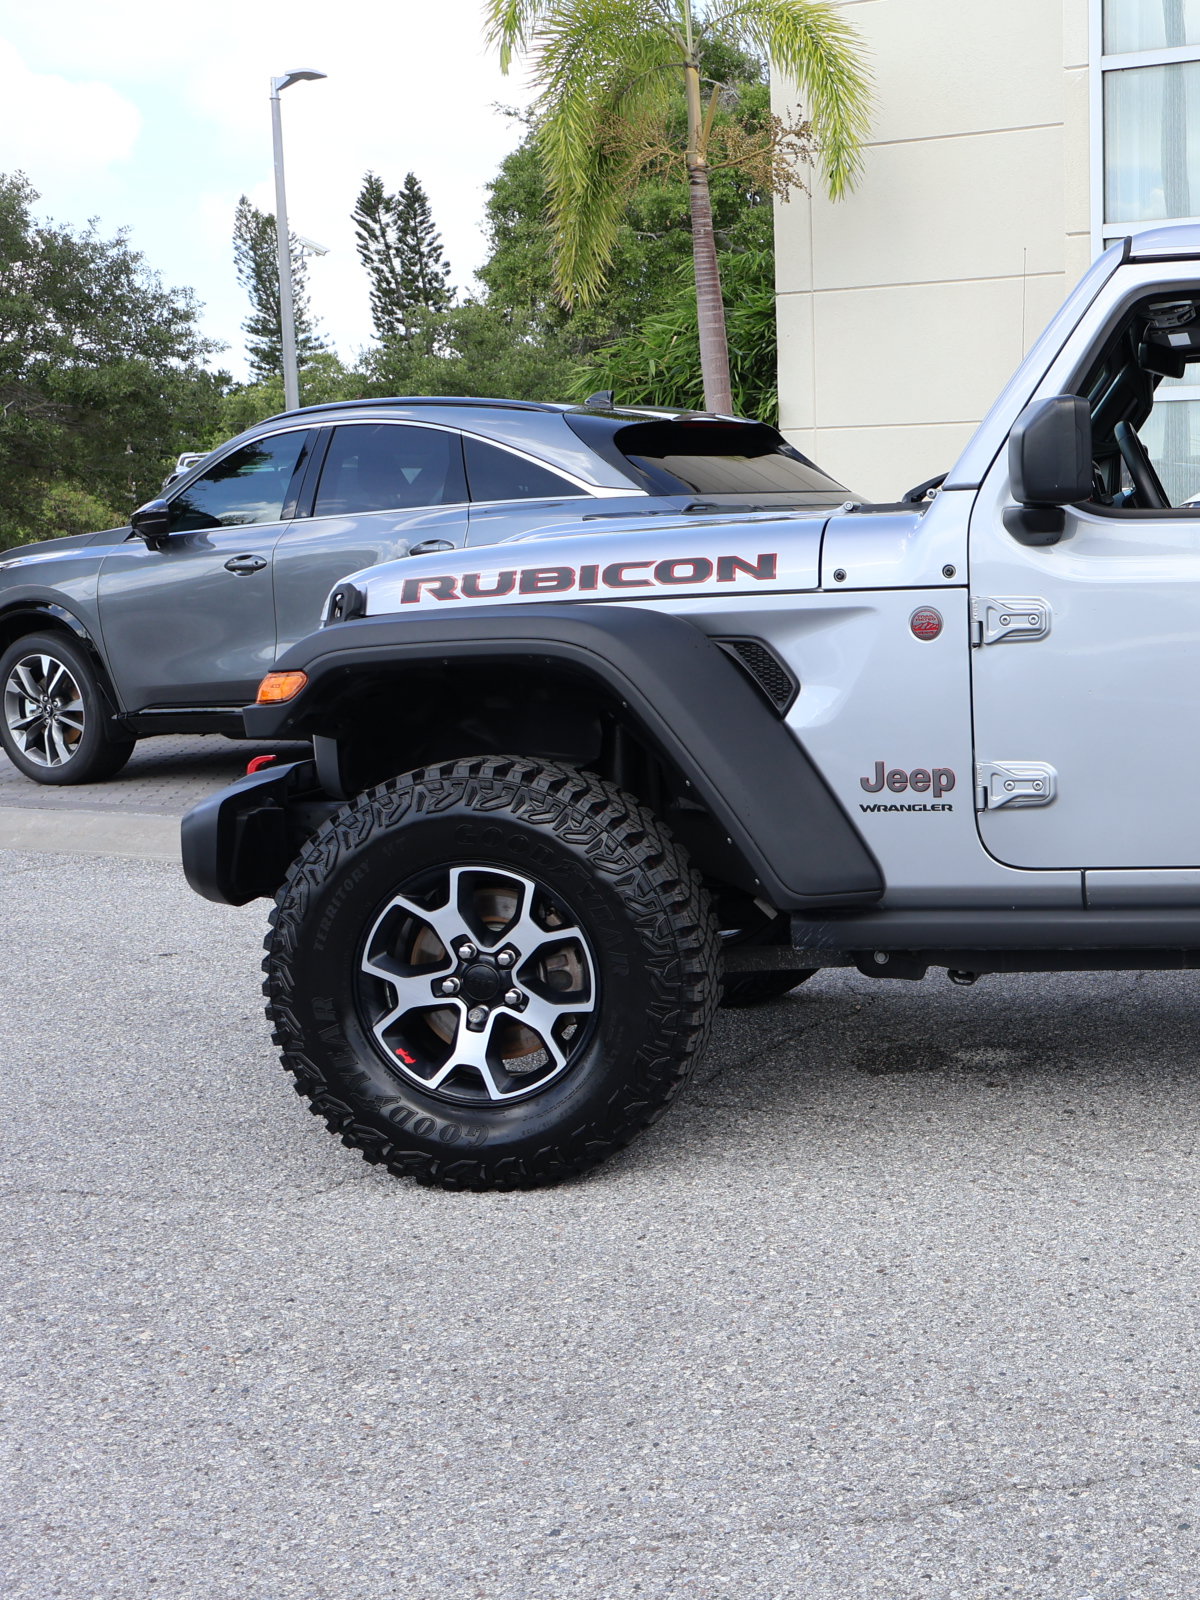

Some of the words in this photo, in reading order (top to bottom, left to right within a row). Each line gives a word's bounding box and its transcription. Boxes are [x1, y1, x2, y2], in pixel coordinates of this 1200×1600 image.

[400, 553, 777, 604] RUBICON
[860, 761, 955, 798] Jeep
[859, 804, 953, 812] WRANGLER
[313, 859, 370, 951] TERRITORY
